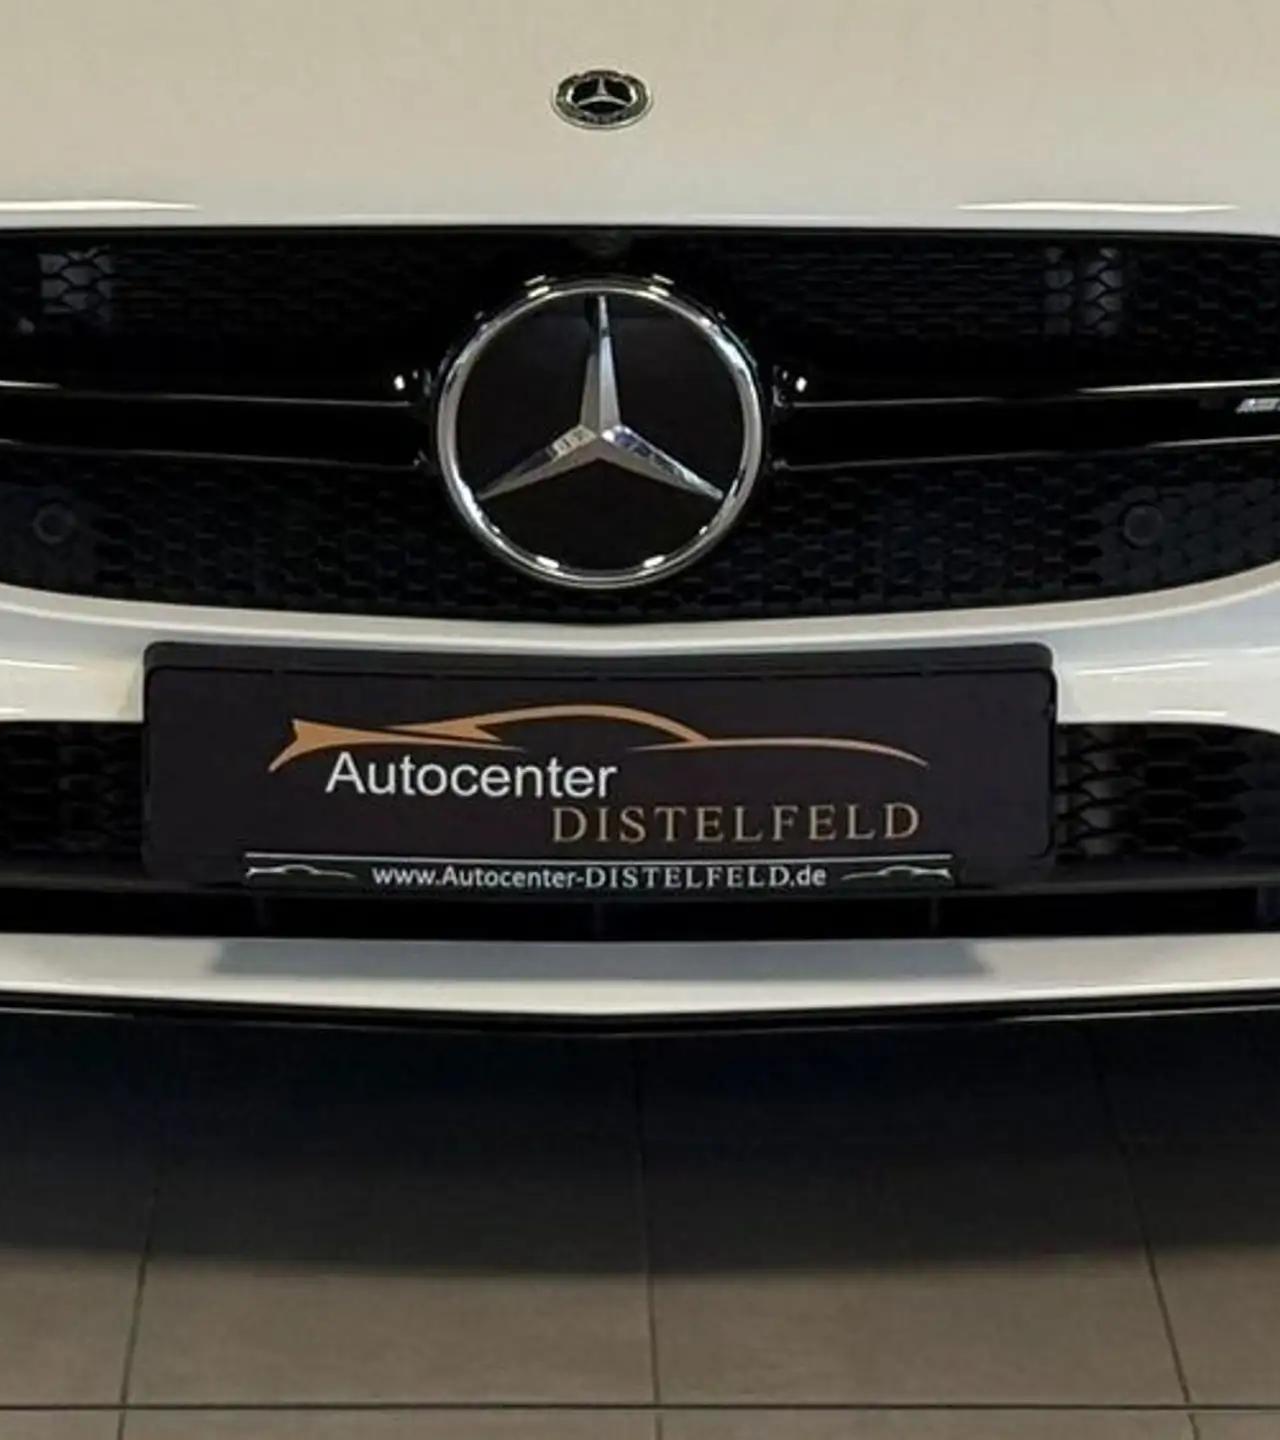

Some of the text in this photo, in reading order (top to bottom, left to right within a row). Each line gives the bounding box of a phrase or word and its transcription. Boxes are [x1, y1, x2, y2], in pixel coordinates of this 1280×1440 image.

[325, 751, 618, 799] Autocenter
[552, 802, 920, 844] DISTELFELD
[371, 863, 827, 890] www.Autocenter-DISTELFELD.de
